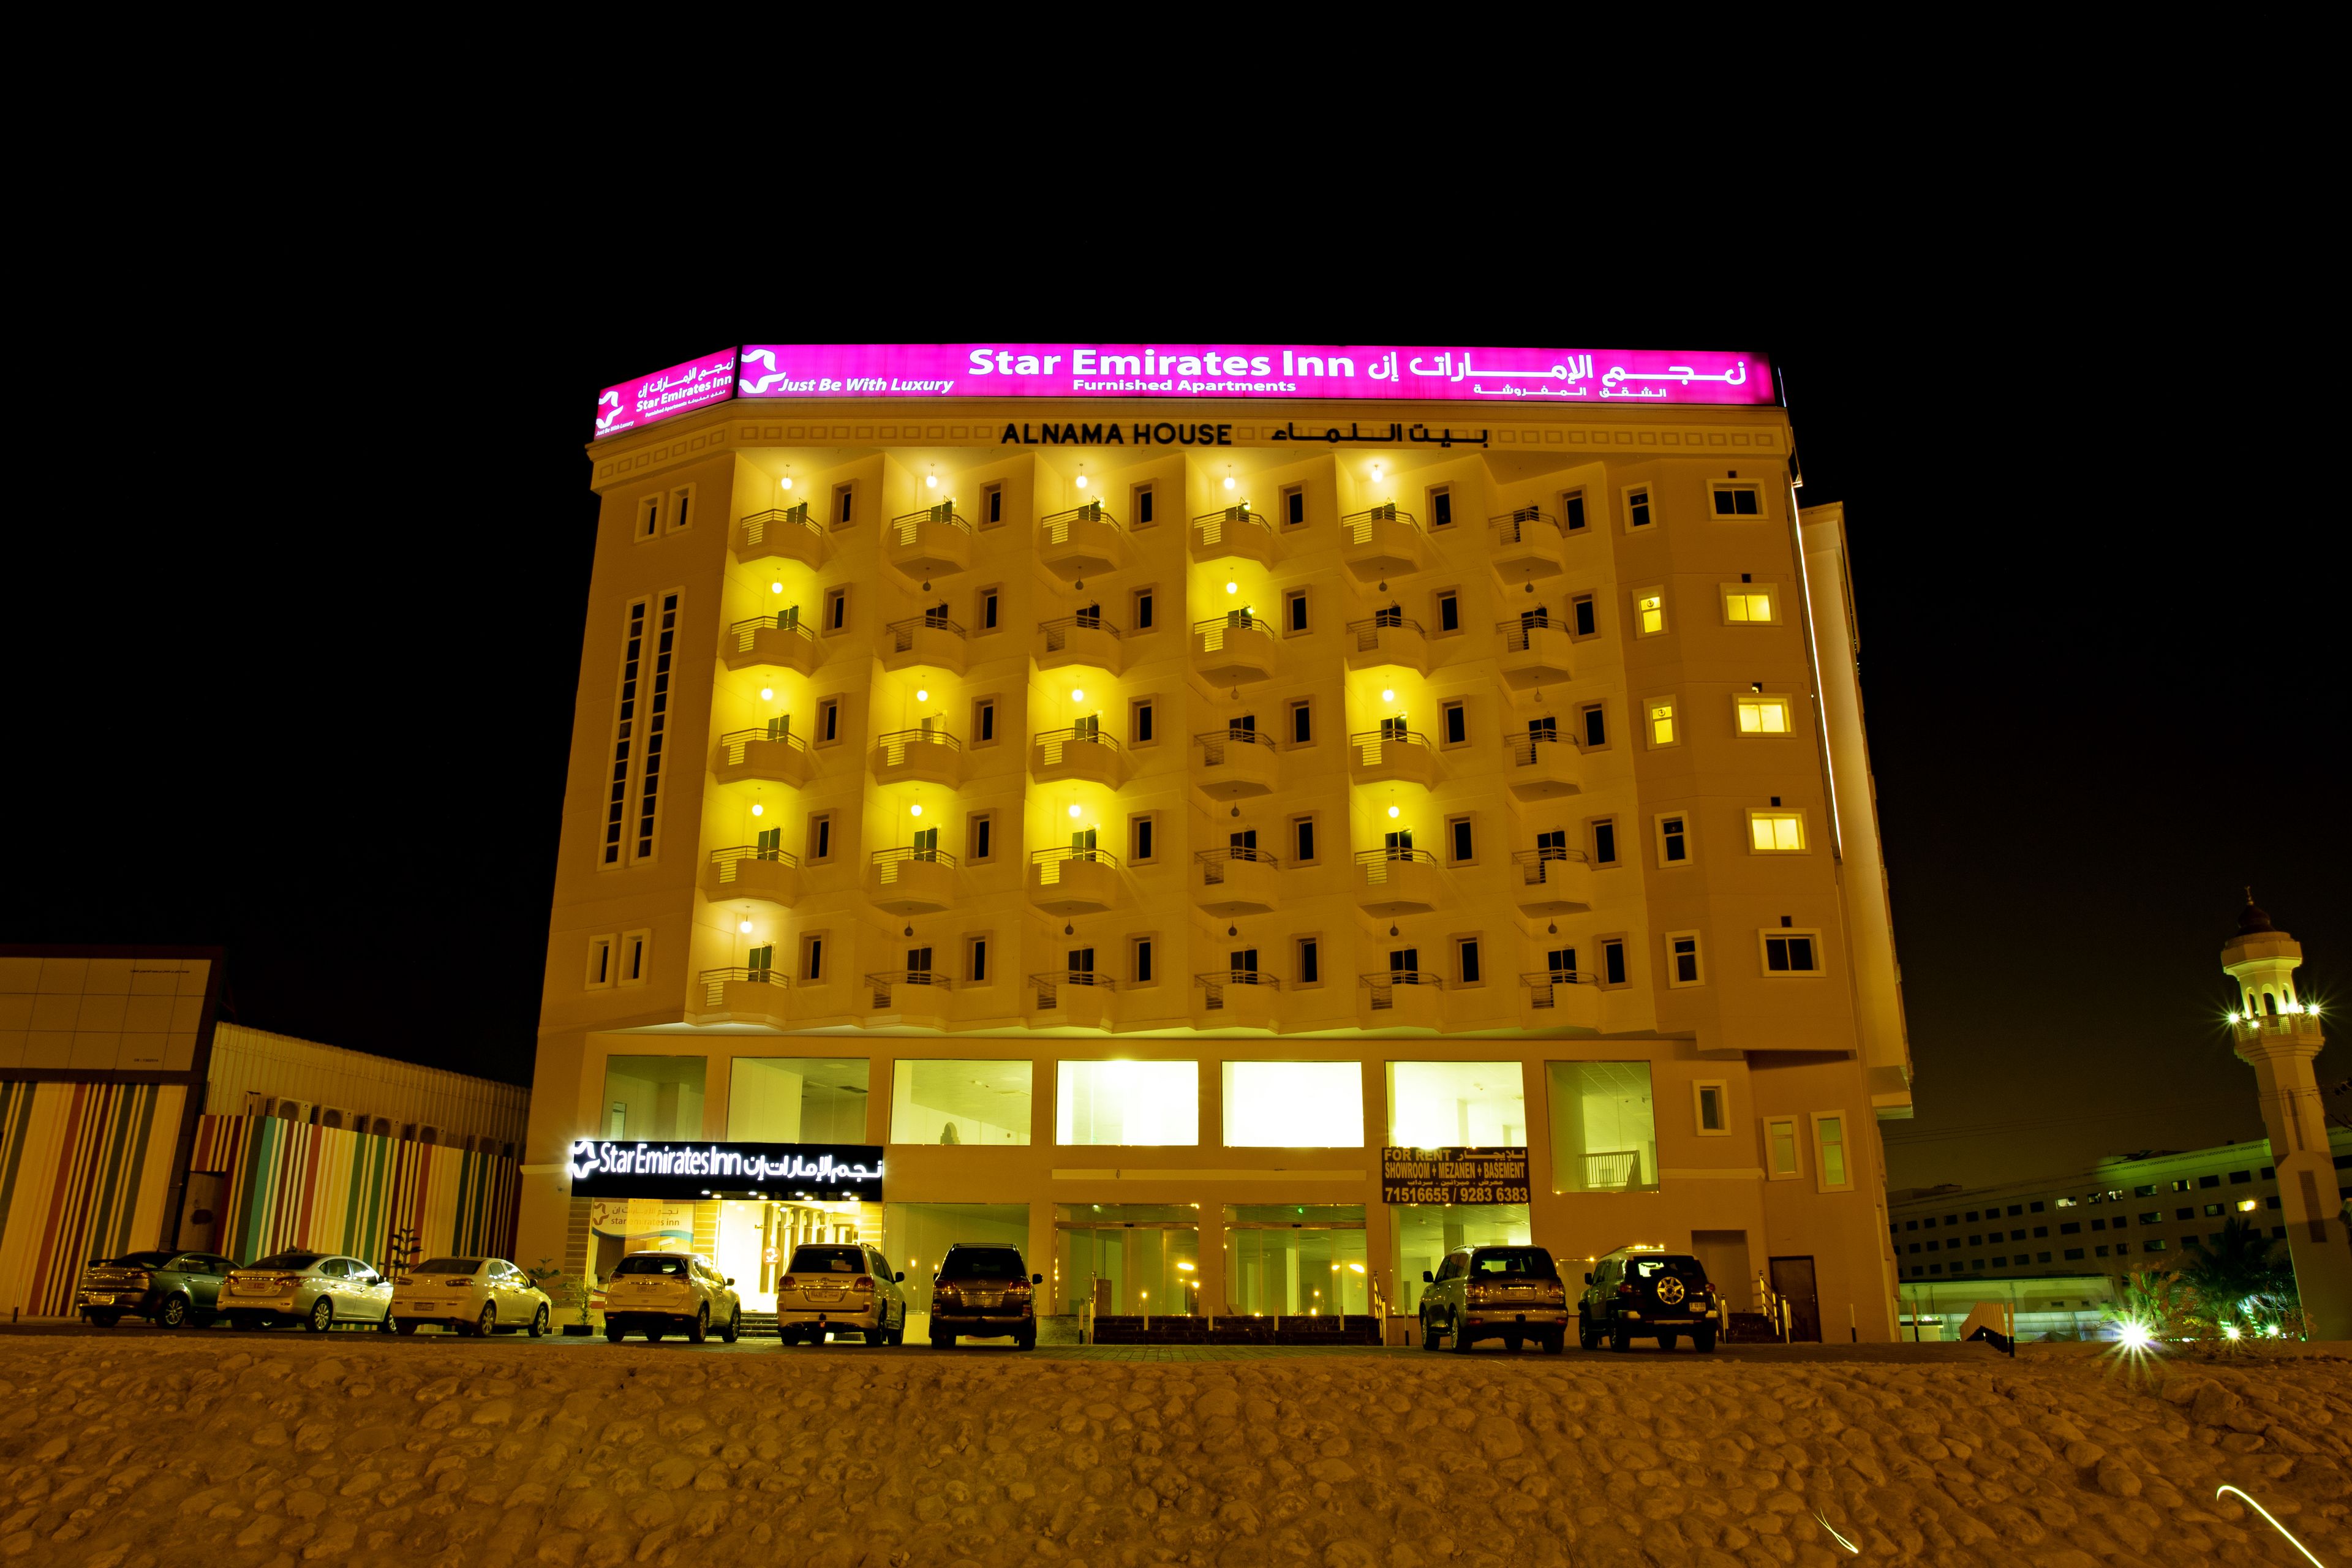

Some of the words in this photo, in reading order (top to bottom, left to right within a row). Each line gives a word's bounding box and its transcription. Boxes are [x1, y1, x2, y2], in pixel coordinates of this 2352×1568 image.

[698, 356, 734, 381] نجم
[967, 348, 1061, 376] Star
[1072, 349, 1272, 377] Emirates
[1283, 350, 1355, 377] Inn
[1409, 352, 1594, 385] الإمارات
[1601, 361, 1747, 388] نجم
[636, 397, 660, 412] Star
[661, 381, 711, 405] Emirates
[712, 375, 732, 388] Inn
[777, 379, 816, 391] Just
[818, 378, 842, 391] Be
[846, 377, 888, 391] With
[890, 378, 954, 394] Luxury
[1072, 379, 1172, 391] Furnished
[1177, 379, 1297, 393] Apartments
[1473, 383, 1587, 396] المفروشة
[1599, 386, 1667, 398] الشقق
[645, 407, 665, 418] Furnished
[665, 401, 687, 412] Apartments
[620, 421, 635, 429] Luxury
[1001, 423, 1125, 445] ALNAMA
[1134, 422, 1232, 445] HOUSE
[1409, 423, 1488, 448] بيت
[599, 1142, 635, 1173] Star
[635, 1143, 710, 1175] Emirates
[710, 1145, 742, 1175] Inn
[1384, 1149, 1412, 1161] FOR
[1415, 1149, 1452, 1161] RENT
[831, 1160, 883, 1183] نجم
[1385, 1162, 1430, 1178] SHOWROOM
[1438, 1163, 1476, 1178] MEZANEN
[1483, 1163, 1525, 1178] BASEMENT
[1385, 1187, 1450, 1202] 71516655
[1460, 1187, 1493, 1202] 9283
[1496, 1187, 1528, 1202] 6383
